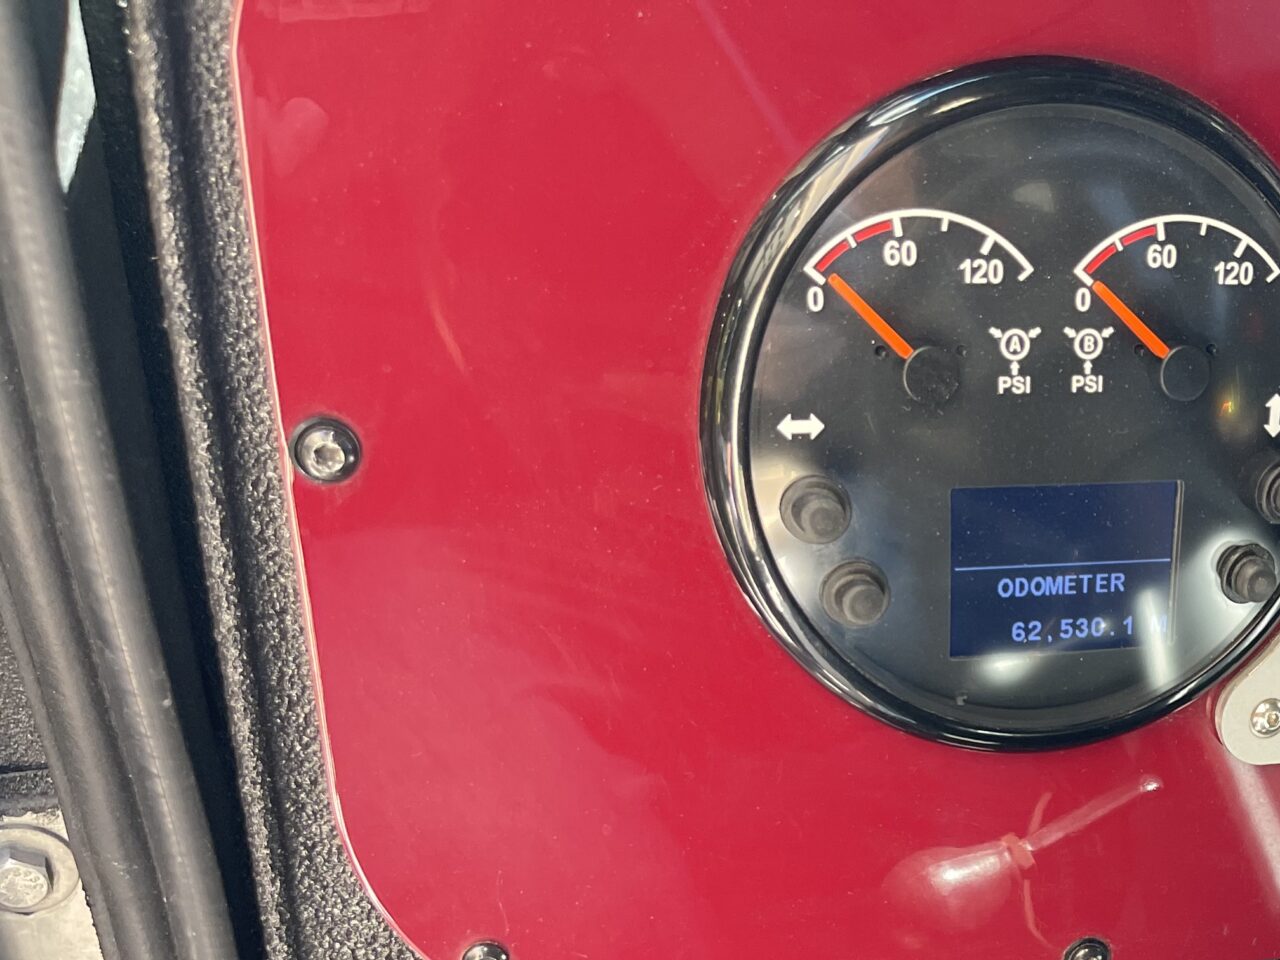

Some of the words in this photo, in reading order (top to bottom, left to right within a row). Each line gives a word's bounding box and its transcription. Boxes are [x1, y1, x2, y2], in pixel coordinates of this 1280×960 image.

[883, 240, 917, 266] 60
[1147, 244, 1177, 268] 60
[960, 258, 1003, 285] 120
[1214, 262, 1253, 285] 120
[807, 288, 824, 312] 0
[1075, 288, 1091, 311] 0
[1009, 336, 1020, 353] A
[998, 376, 1031, 394] PSI
[1071, 375, 1103, 393] PSI
[997, 573, 1126, 598] ODOMETER
[1011, 615, 1133, 642] 62,530.1
